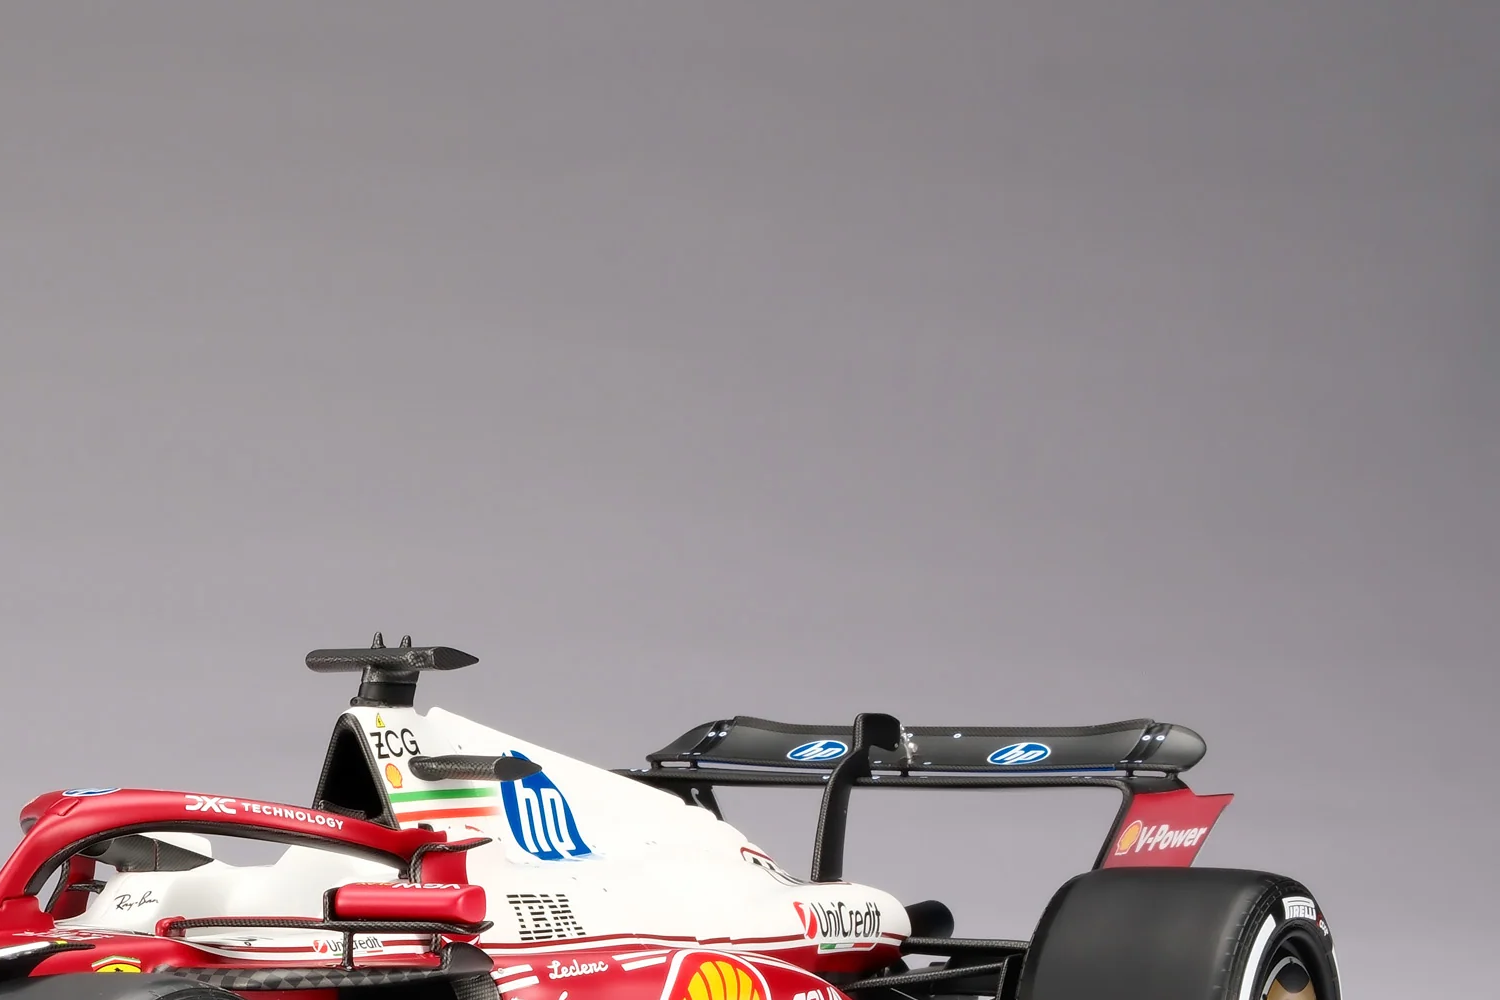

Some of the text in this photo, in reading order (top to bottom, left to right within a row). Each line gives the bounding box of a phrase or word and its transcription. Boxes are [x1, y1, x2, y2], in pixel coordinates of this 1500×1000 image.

[792, 740, 846, 762] hp
[993, 742, 1046, 765] hp
[184, 795, 344, 830] DXC TECHNOLOGY
[1137, 823, 1206, 853] V-Power
[114, 891, 159, 910] Ray-Ban
[1282, 896, 1317, 920] PIRELLI
[506, 893, 586, 941] IBM
[811, 902, 882, 938] UniCredit
[549, 959, 609, 980] Leclerc
